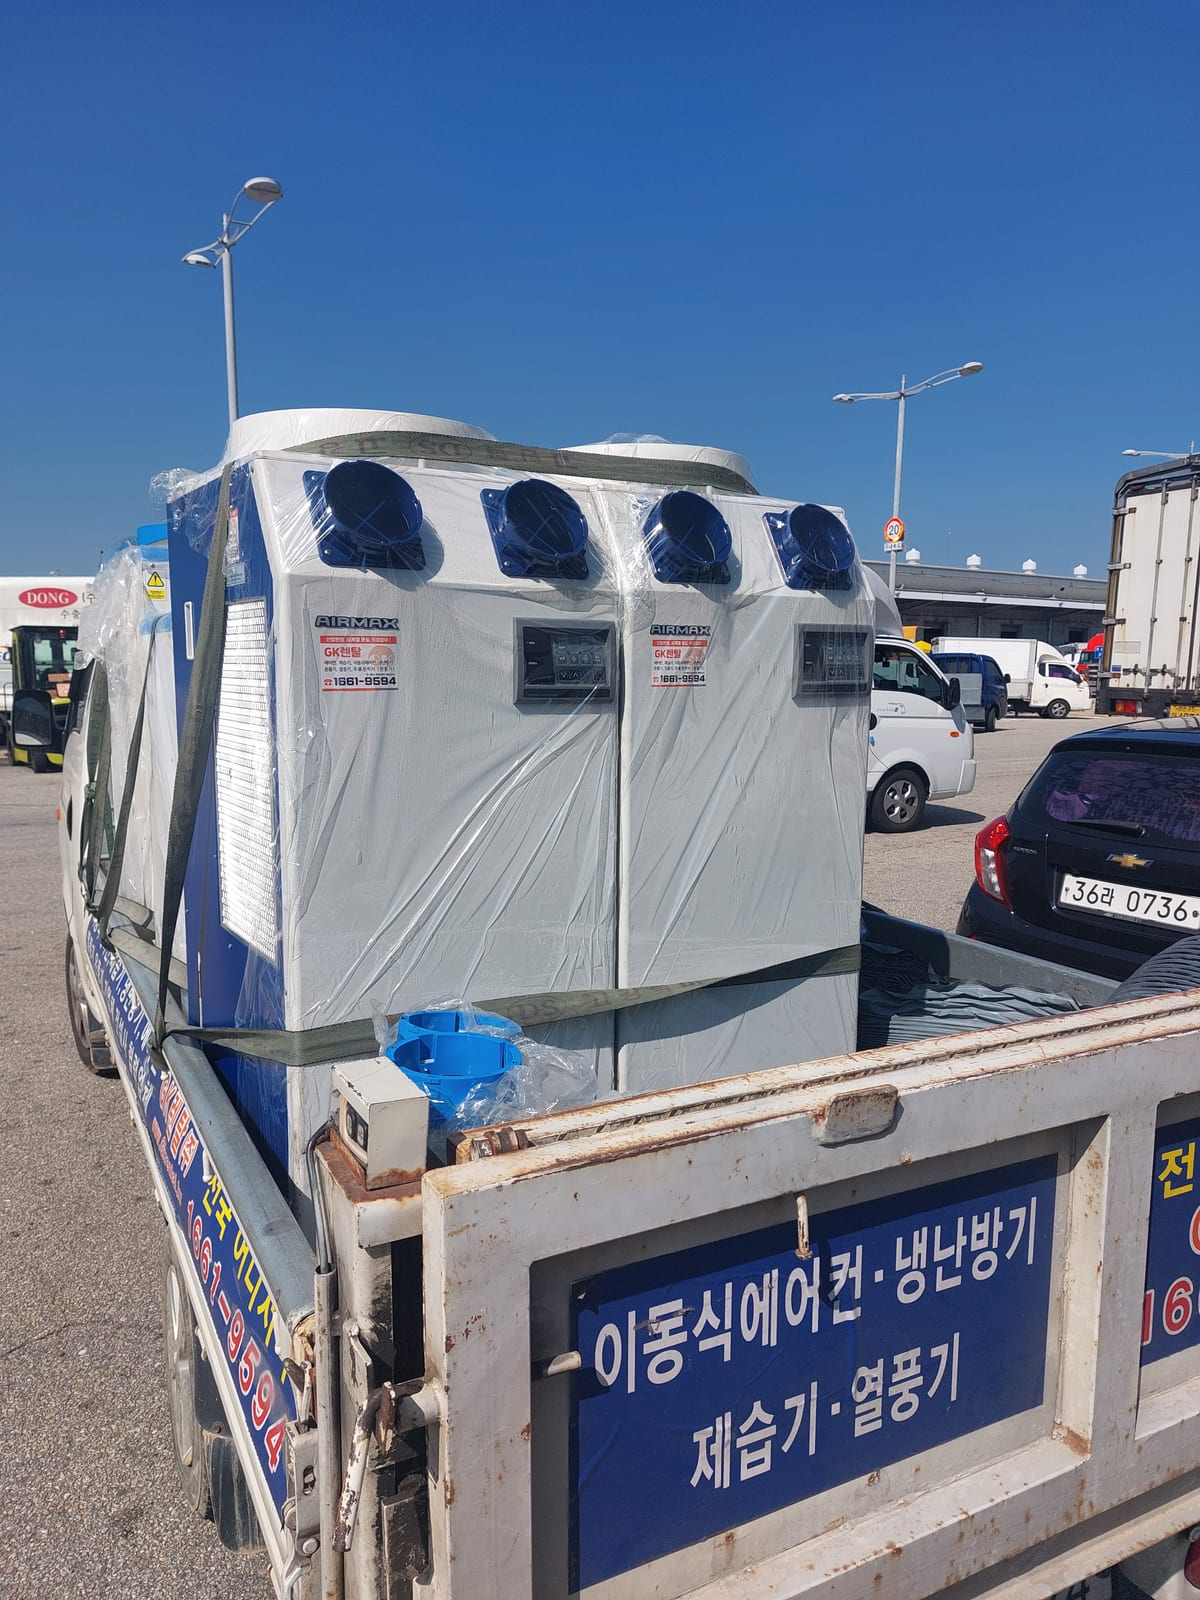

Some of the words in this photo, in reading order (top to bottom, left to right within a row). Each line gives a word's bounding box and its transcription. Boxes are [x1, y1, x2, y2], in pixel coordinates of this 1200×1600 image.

[889, 524, 900, 536] 20
[27, 591, 70, 605] DONG
[315, 614, 400, 631] AIRMAX
[650, 624, 711, 636] AIRMAX
[324, 646, 362, 658] GK렌탈
[655, 648, 682, 659] GK렌탈
[334, 677, 397, 686] 1661-9594
[660, 674, 706, 683] 1661-9594
[1072, 880, 1115, 907] 36라
[1126, 890, 1188, 922] 0736
[187, 1200, 287, 1473] 1661-9594
